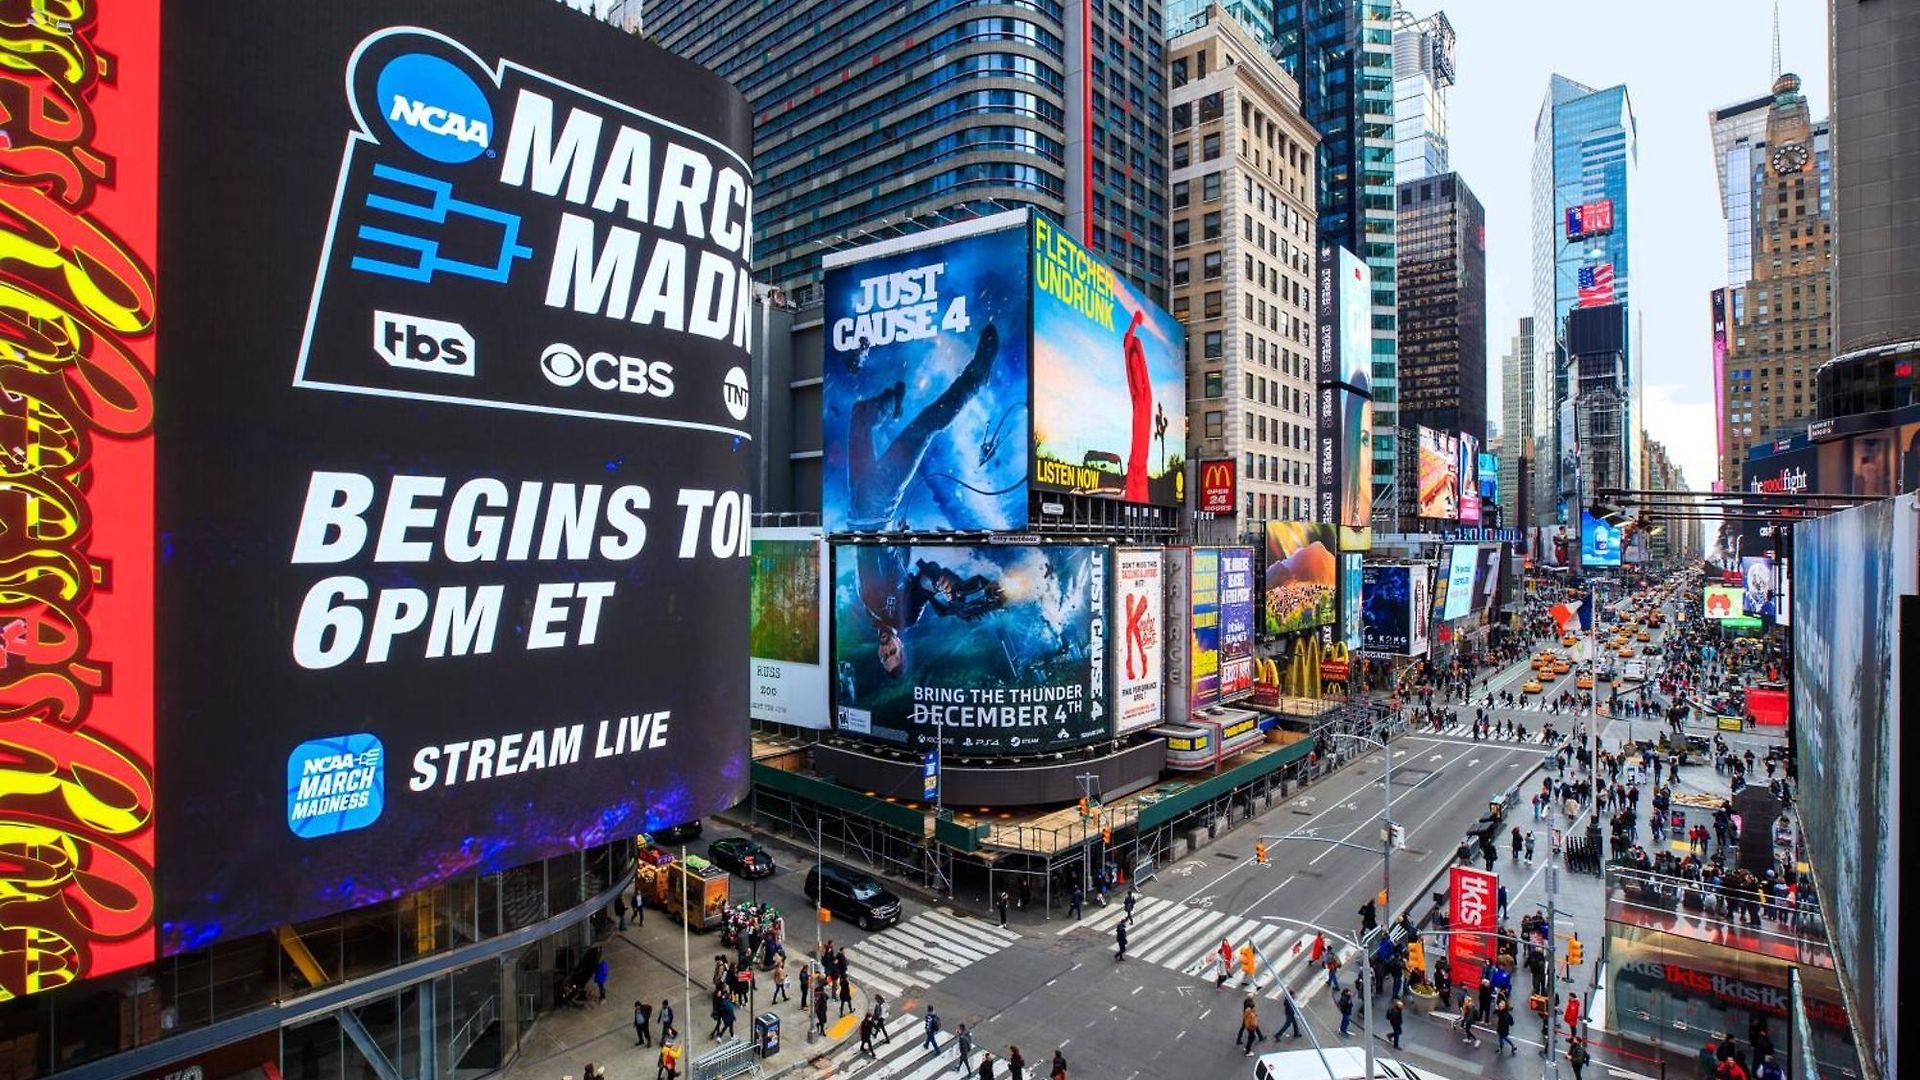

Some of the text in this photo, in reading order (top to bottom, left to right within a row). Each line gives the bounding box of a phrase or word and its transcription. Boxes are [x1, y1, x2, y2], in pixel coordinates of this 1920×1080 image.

[389, 94, 488, 149] NCAA
[1036, 217, 1115, 300] FLETCHER
[856, 262, 945, 314] JUST
[1036, 252, 1115, 332] UNDRUNK
[833, 295, 971, 352] CAUSE 4
[384, 320, 750, 408] tbs CBS TNT
[1036, 459, 1100, 489] LISTEN NOW
[1209, 494, 1227, 505] 24
[290, 470, 652, 565] BEGINS
[291, 575, 617, 671] 6PM ET
[1091, 550, 1103, 721] JUST CAUSE 4
[1169, 561, 1182, 684] PALACE
[757, 665, 781, 679] RUSS
[914, 684, 1083, 703] BRING THE THUNDER
[913, 700, 1083, 728] DECEMBER 4TH
[303, 751, 354, 773] NCAA
[409, 710, 672, 793] STREAM LIVE
[291, 790, 370, 822] MADNESS
[296, 764, 376, 801] MARCH
[1461, 874, 1490, 927] tkts
